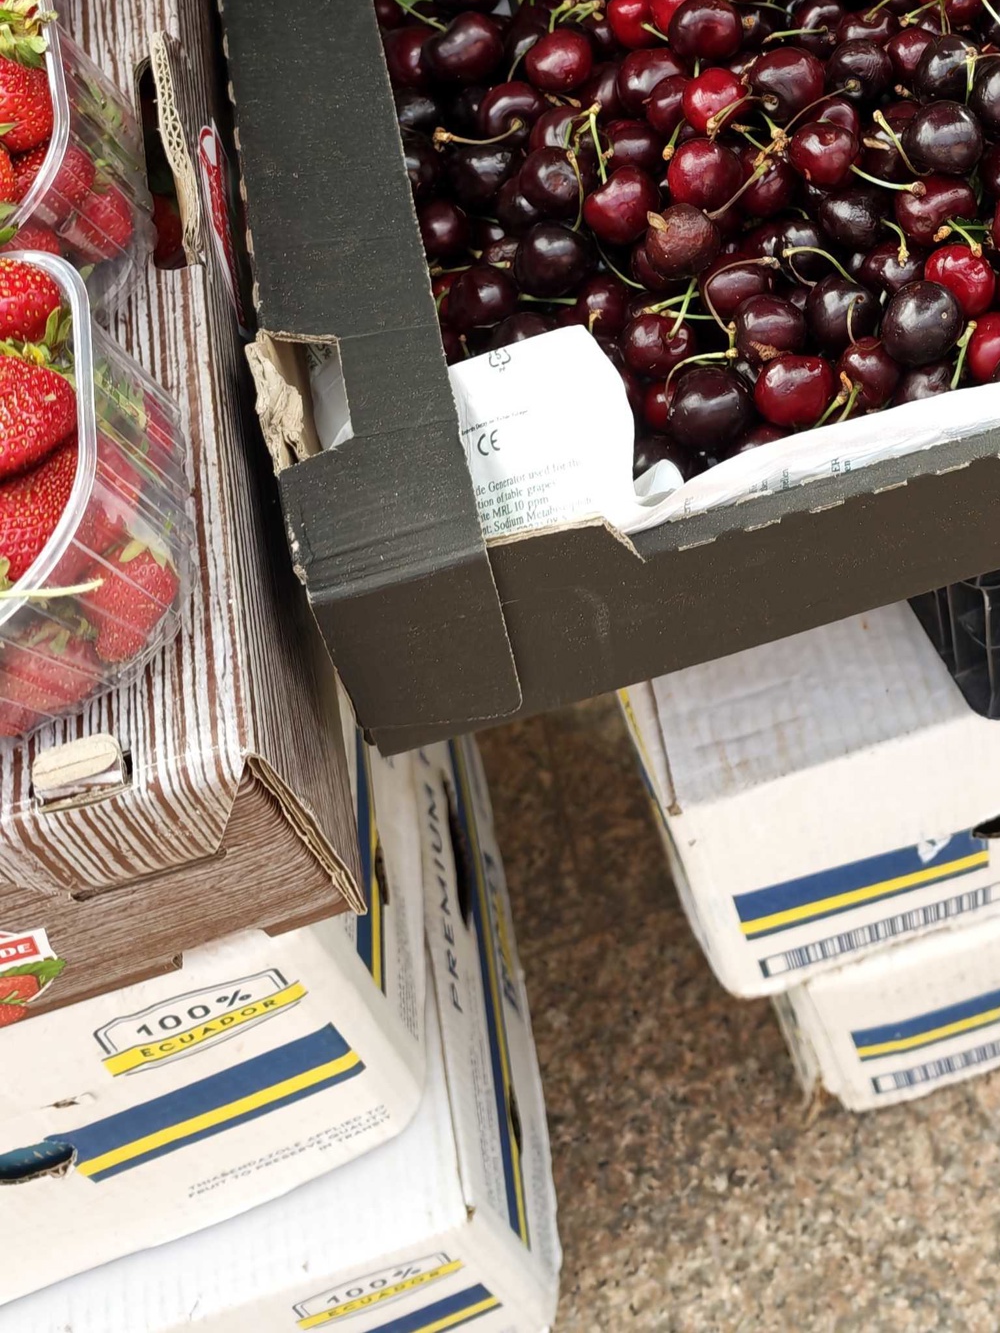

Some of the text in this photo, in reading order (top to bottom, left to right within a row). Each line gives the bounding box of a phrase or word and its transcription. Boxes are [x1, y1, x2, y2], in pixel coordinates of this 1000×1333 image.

[488, 473, 526, 493] Generator
[492, 504, 513, 520] MRL
[494, 516, 525, 534] Sodium
[135, 989, 254, 1040] 100%
[140, 997, 279, 1059] ECUADOR
[326, 1267, 422, 1306] 100%
[327, 1269, 440, 1318] ECUADOR
